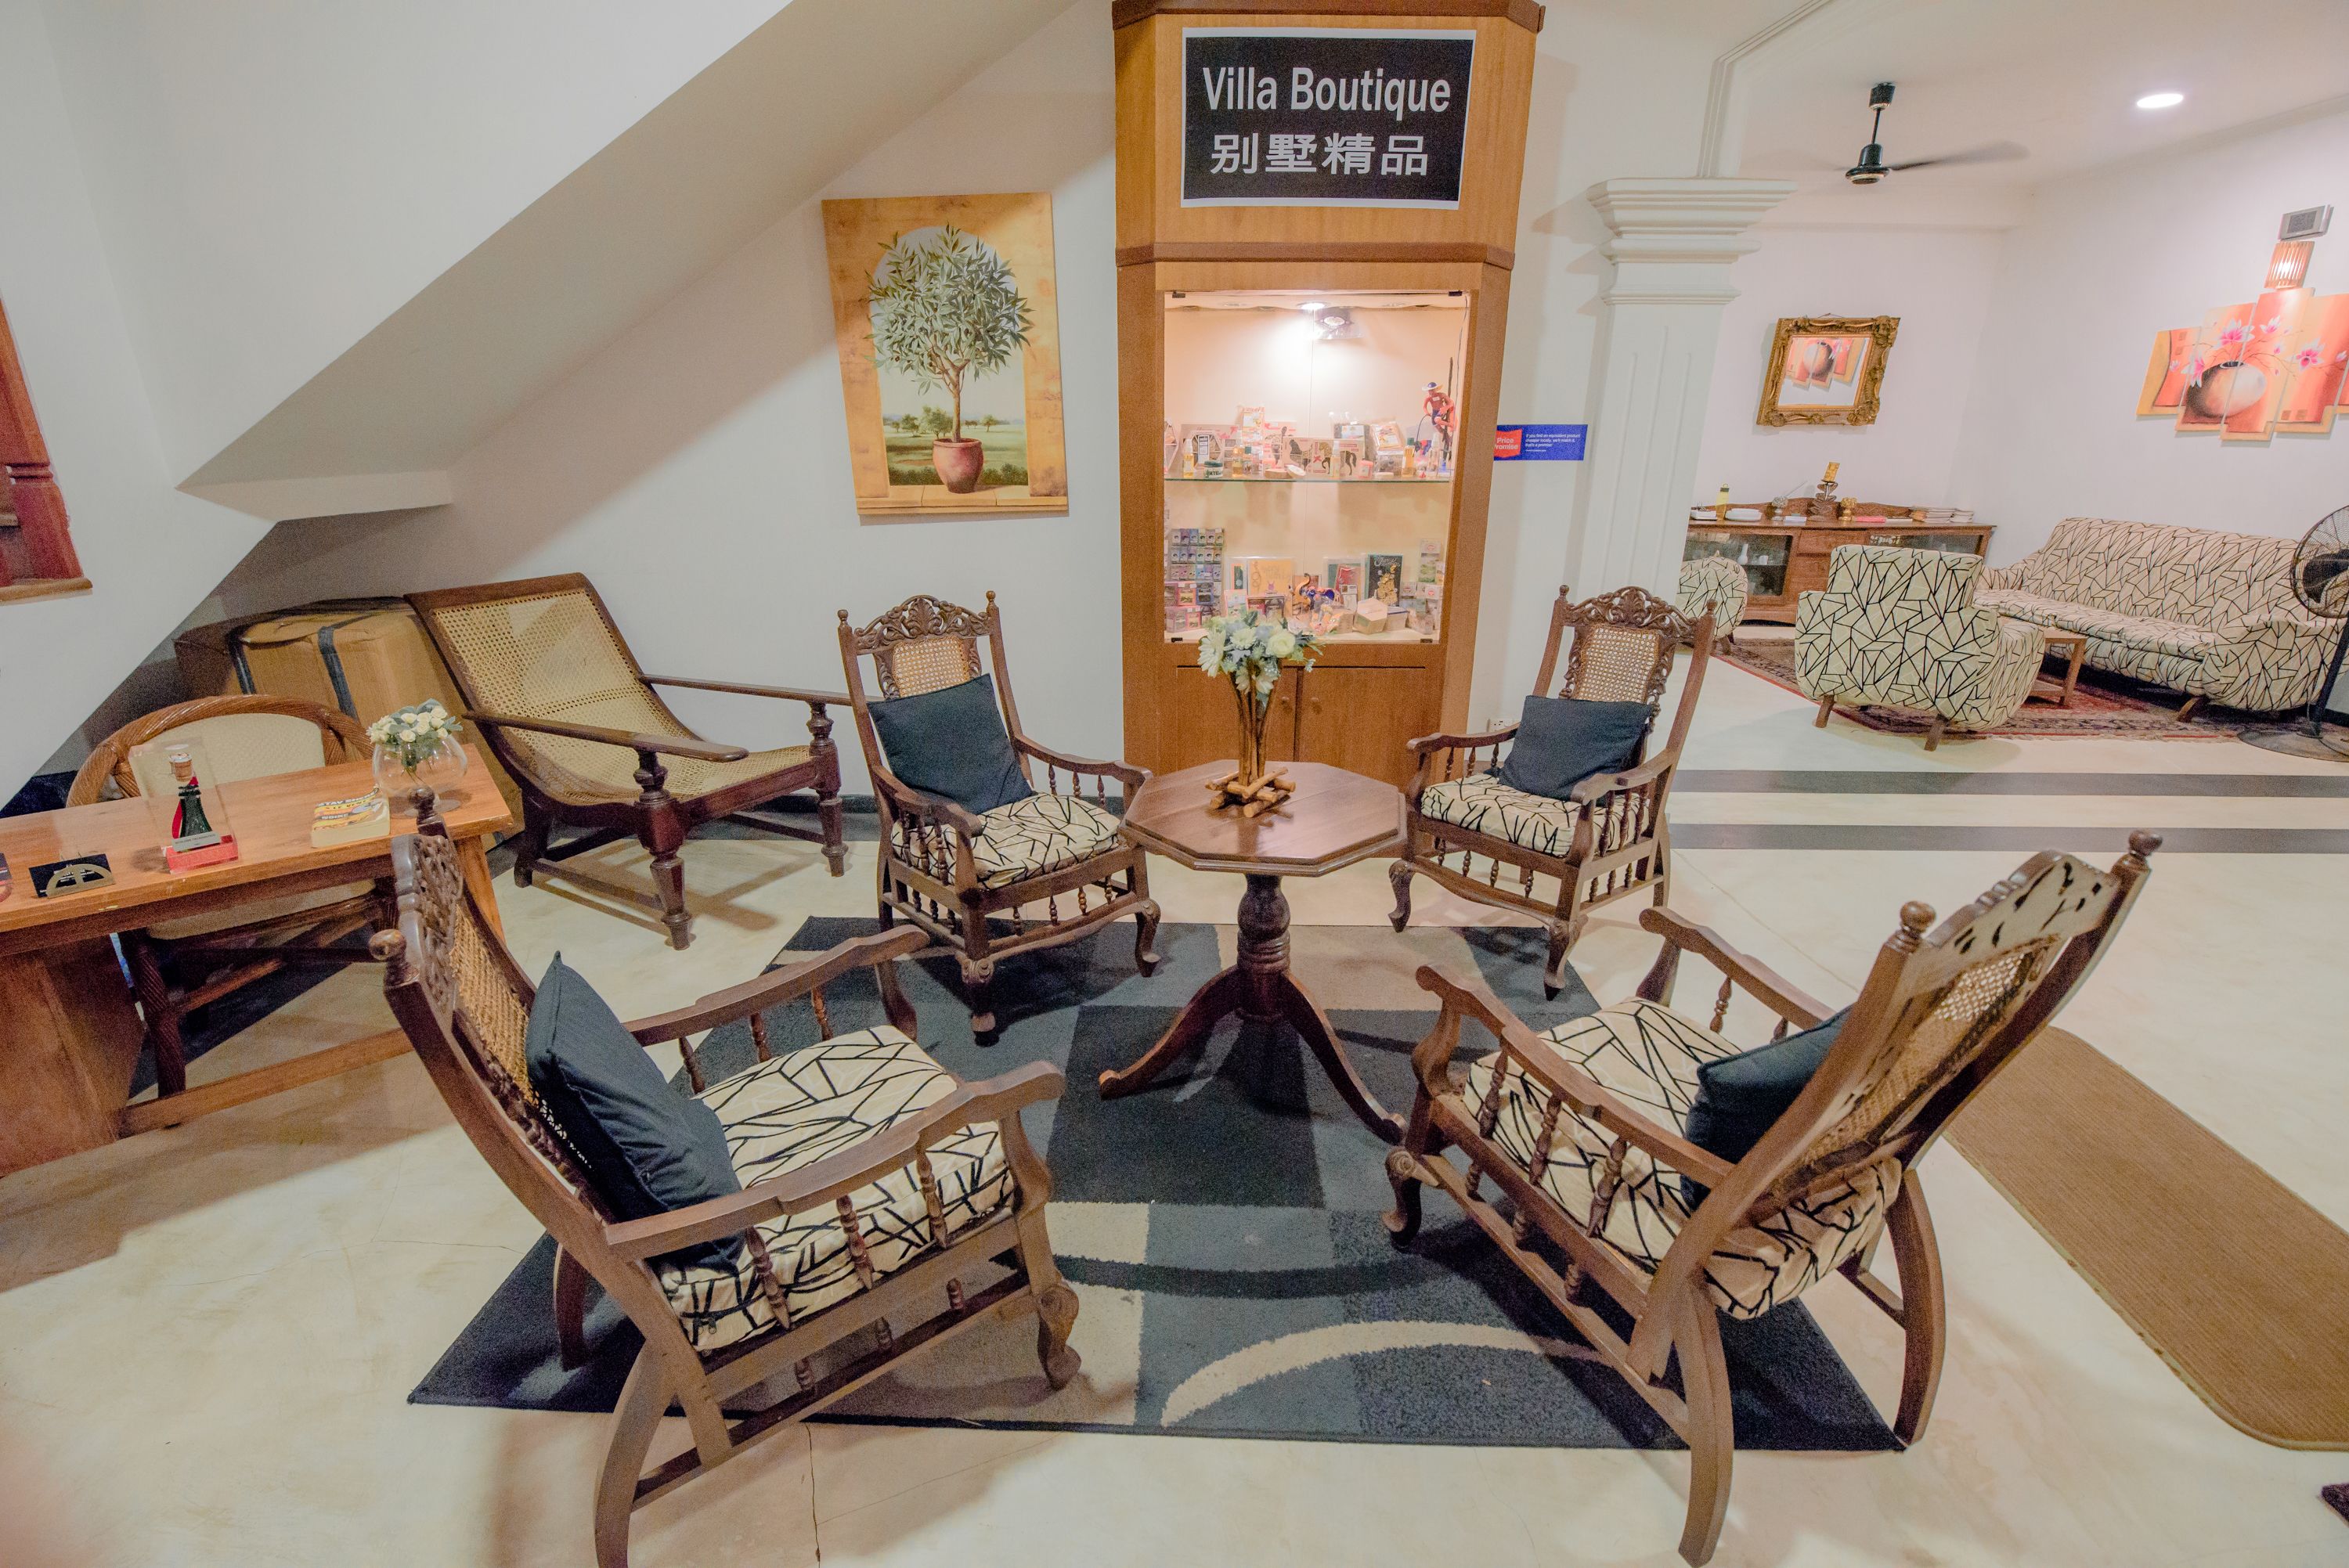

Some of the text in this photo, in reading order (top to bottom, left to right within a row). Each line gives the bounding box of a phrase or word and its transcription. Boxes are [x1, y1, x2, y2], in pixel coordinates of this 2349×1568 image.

[1202, 67, 1451, 121] Villa Boutique
[1210, 132, 1429, 176] 别墅精品
